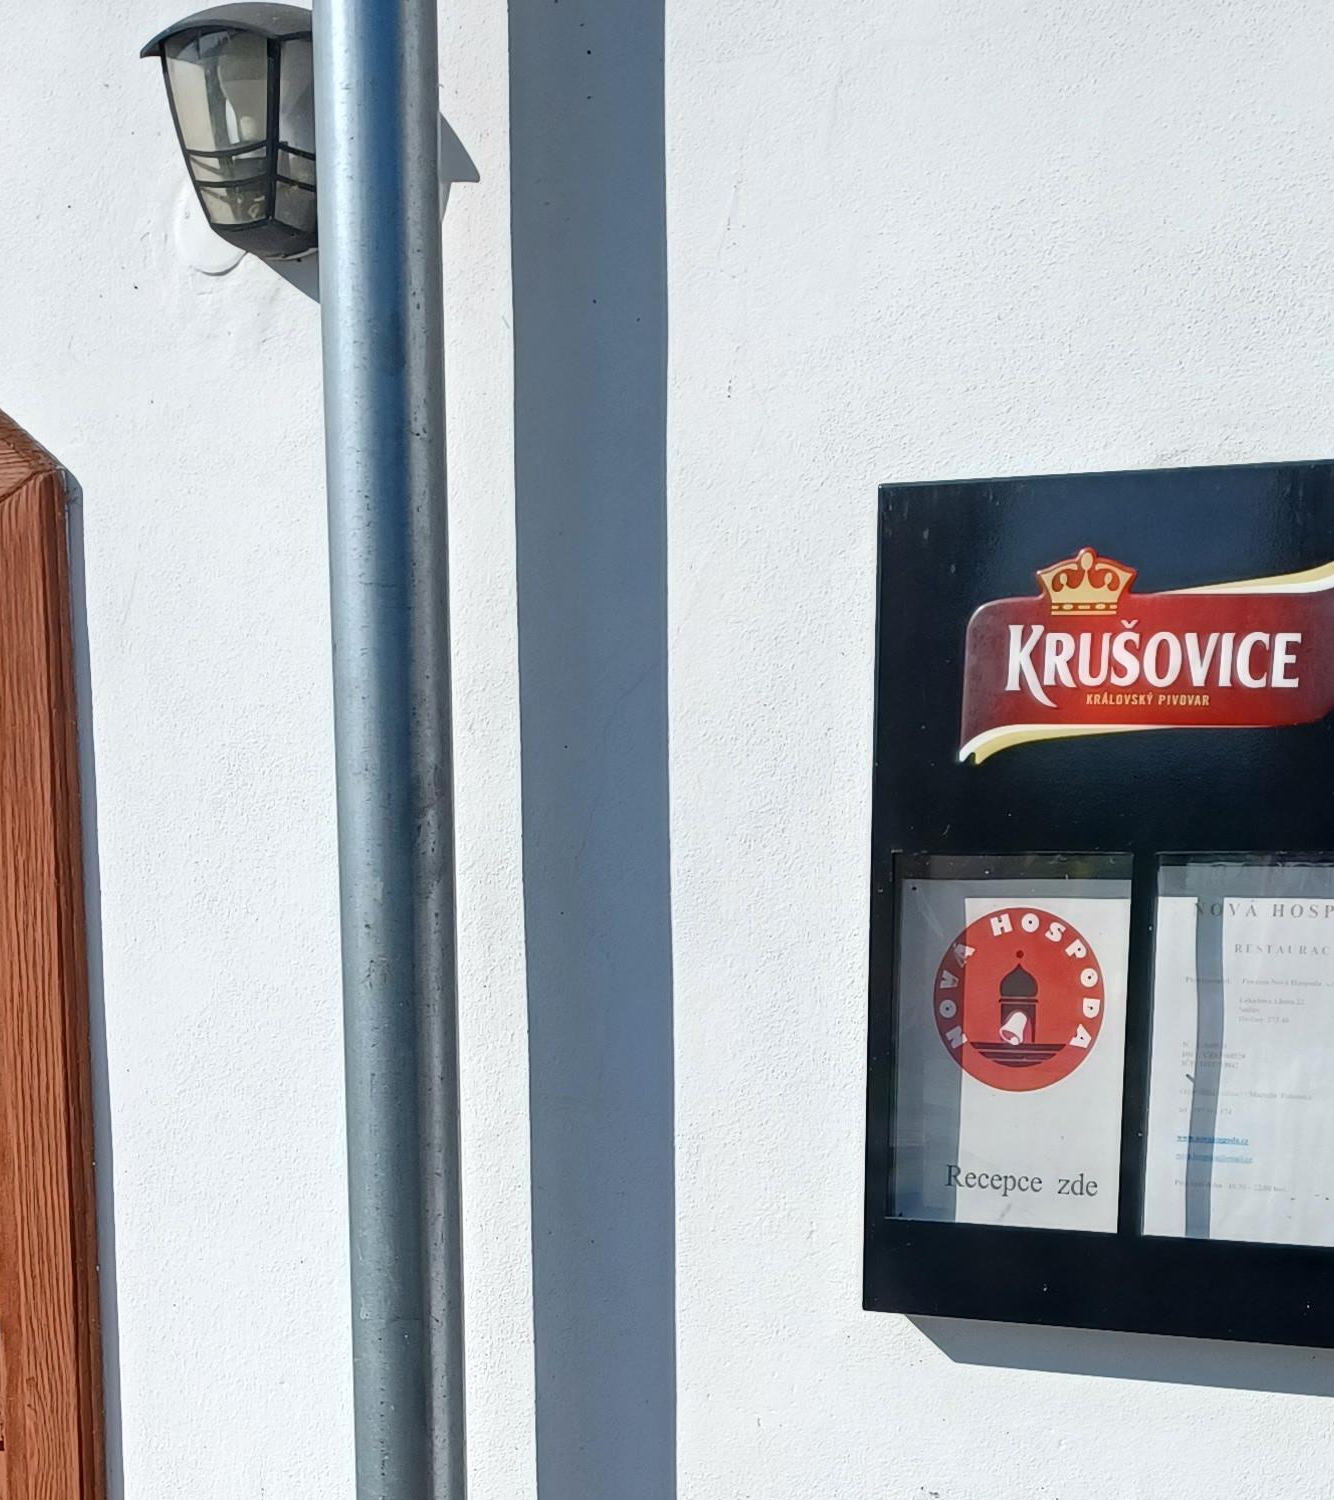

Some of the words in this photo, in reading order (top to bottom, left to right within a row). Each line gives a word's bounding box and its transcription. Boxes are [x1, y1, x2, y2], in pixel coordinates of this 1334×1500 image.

[1005, 620, 1302, 708] KRUŠOVICE
[1086, 691, 1154, 705] KRÁLOVSKÝ
[1158, 694, 1210, 706] PIVOVAR
[989, 913, 1101, 1050] HOSPODA
[946, 1163, 1043, 1197] Recepce
[1057, 1172, 1099, 1197] zde
